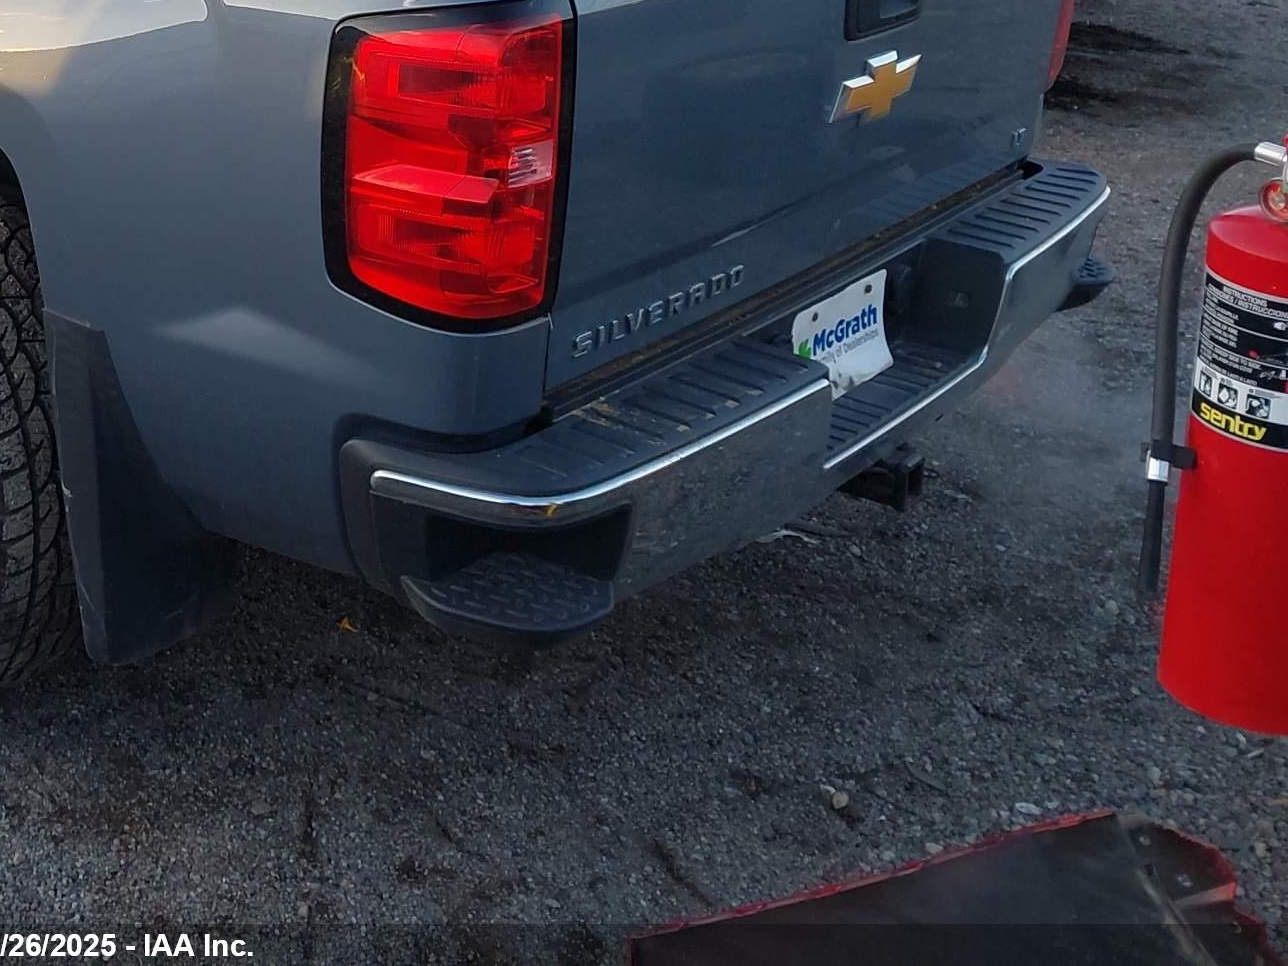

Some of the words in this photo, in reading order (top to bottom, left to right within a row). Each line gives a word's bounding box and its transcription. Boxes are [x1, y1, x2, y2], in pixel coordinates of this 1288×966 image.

[572, 263, 745, 359] SILVERADO
[812, 304, 878, 357] McGrath
[1199, 401, 1268, 441] sentry
